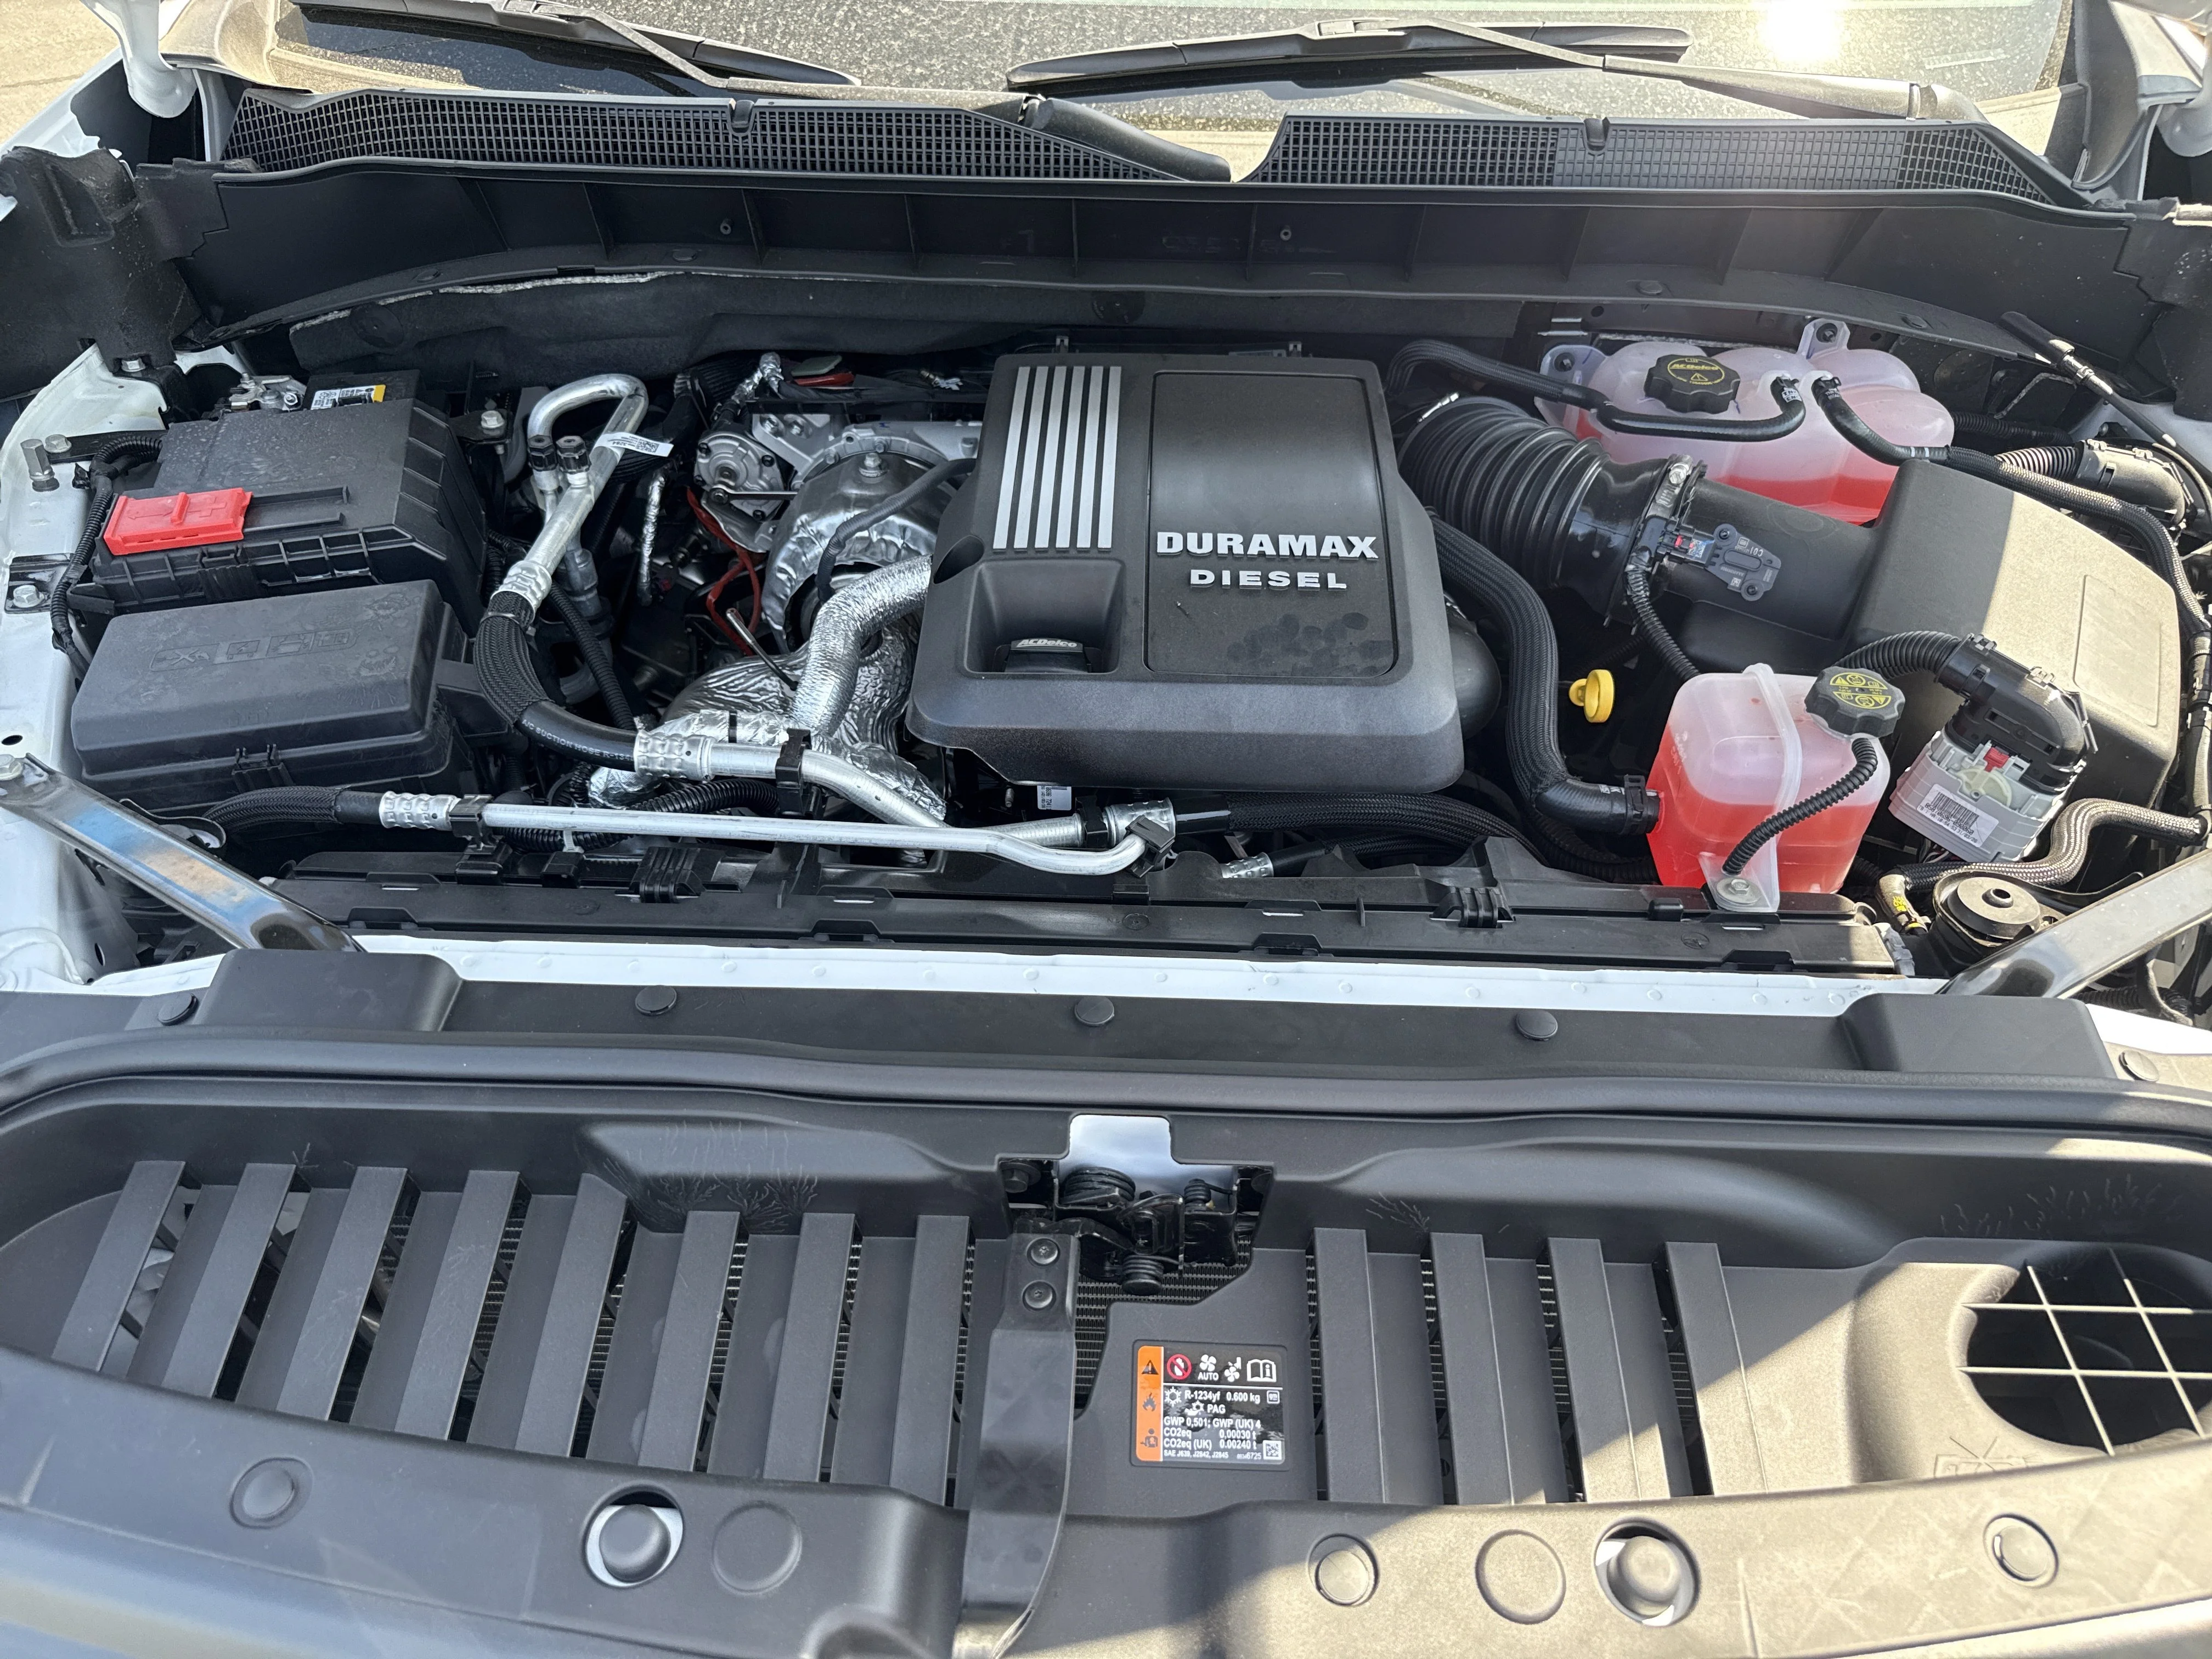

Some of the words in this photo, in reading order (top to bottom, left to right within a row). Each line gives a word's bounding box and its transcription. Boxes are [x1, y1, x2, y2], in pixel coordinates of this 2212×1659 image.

[1157, 532, 1378, 559] DURAMAX
[1190, 569, 1346, 589] DIESEL
[1017, 639, 1077, 647] ACDelco
[522, 719, 534, 730] A/C
[535, 727, 573, 748] SUCTION
[575, 743, 601, 757] HOSE
[1198, 1372, 1219, 1381] AUTO
[1184, 1390, 1221, 1403] R-1234yf
[1226, 1391, 1248, 1402] 0.600
[1250, 1392, 1261, 1404] kg
[1207, 1403, 1226, 1414] PAG
[1164, 1416, 1184, 1426] GWP
[1212, 1418, 1233, 1427] GWP
[1235, 1419, 1254, 1431] (UK)
[1255, 1419, 1261, 1429] 4
[1164, 1427, 1192, 1440] CO2eq
[1252, 1431, 1256, 1440] t
[1164, 1438, 1192, 1450] CO2eq
[1193, 1438, 1212, 1451] (UK)
[1220, 1439, 1251, 1449] 0.00240
[1252, 1441, 1257, 1450] t
